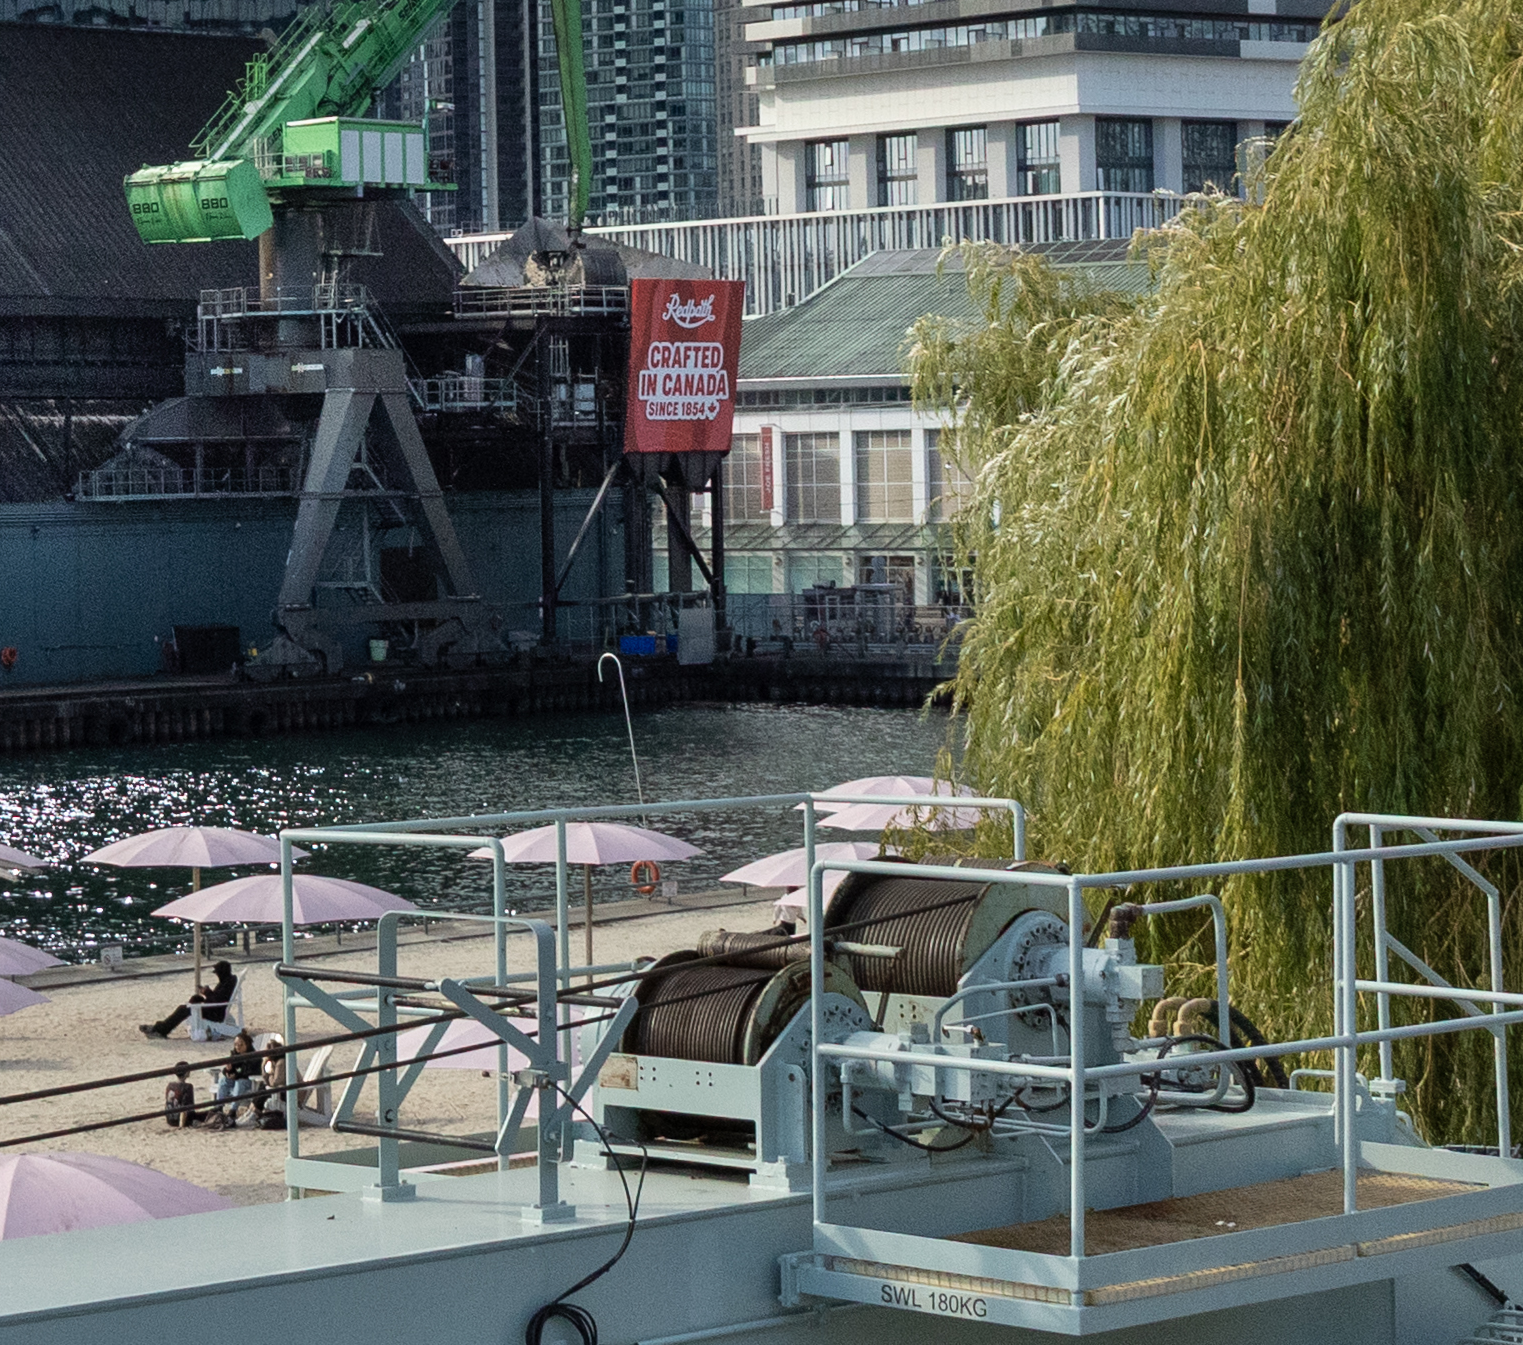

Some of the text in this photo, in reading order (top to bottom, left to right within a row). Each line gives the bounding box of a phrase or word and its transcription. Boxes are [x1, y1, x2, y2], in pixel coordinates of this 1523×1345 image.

[132, 202, 160, 214] 880
[201, 197, 229, 210] 880
[662, 293, 716, 329] Redpath
[651, 345, 721, 369] CRAFTED
[641, 373, 728, 397] IN CANADA
[648, 401, 706, 417] SINCE 1854
[881, 1284, 987, 1318] SWL 180KG
